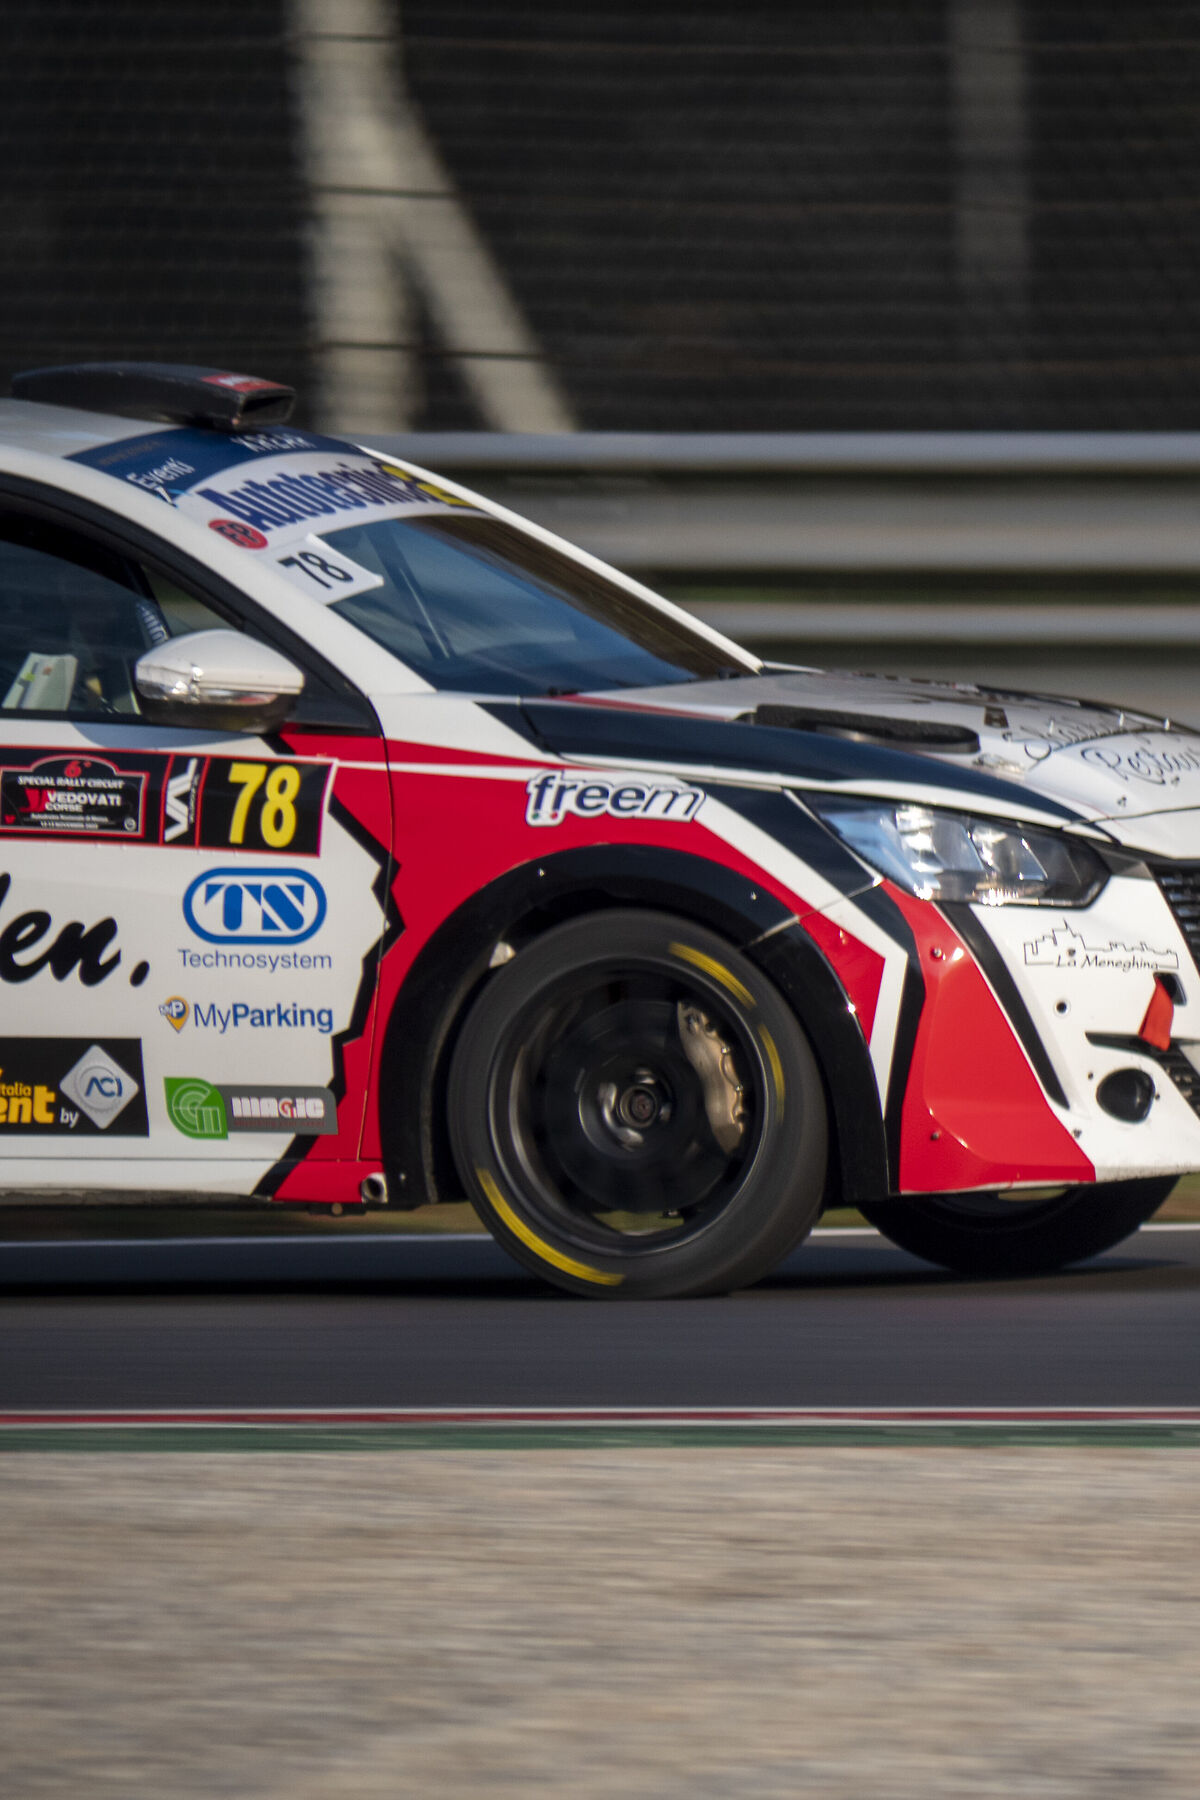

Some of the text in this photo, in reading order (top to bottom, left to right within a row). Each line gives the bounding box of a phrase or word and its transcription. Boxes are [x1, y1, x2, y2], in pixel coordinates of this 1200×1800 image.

[277, 551, 354, 589] 78
[18, 775, 125, 790] SPECIAL RALLY CIRCUIT
[47, 790, 122, 808] VEDOVATI
[228, 762, 301, 848] 78
[532, 774, 700, 819] freem
[177, 949, 333, 973] Technosystem
[1056, 953, 1159, 973] La Meneghina
[193, 1002, 334, 1034] MyParking
[0, 1081, 32, 1097] talia
[85, 1076, 123, 1098] ACI
[60, 1107, 79, 1129] by
